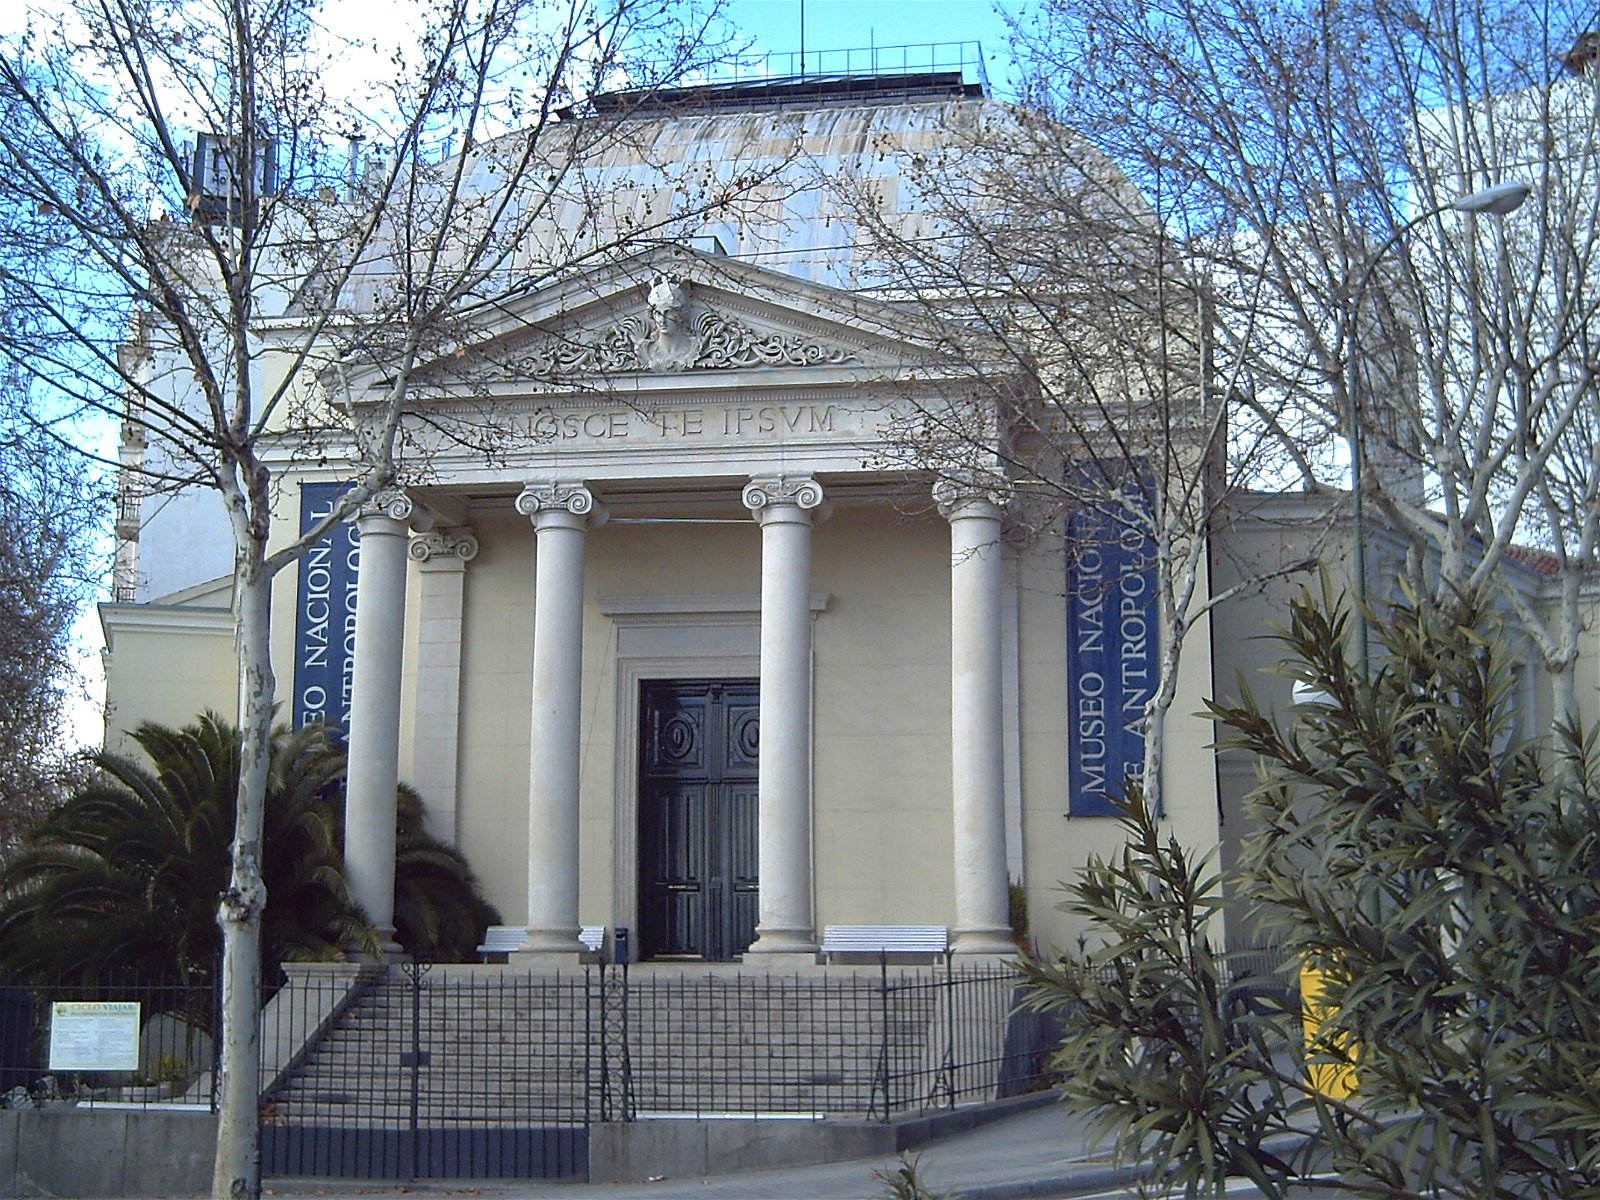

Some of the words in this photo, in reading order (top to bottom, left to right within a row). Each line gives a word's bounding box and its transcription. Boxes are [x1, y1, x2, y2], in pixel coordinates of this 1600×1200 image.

[509, 412, 628, 441] NOSCE
[652, 408, 703, 437] TE
[722, 403, 835, 434] IPSVM
[305, 501, 334, 668] NACIONL
[1077, 490, 1104, 653] NACION
[1079, 671, 1105, 794] MUSEO
